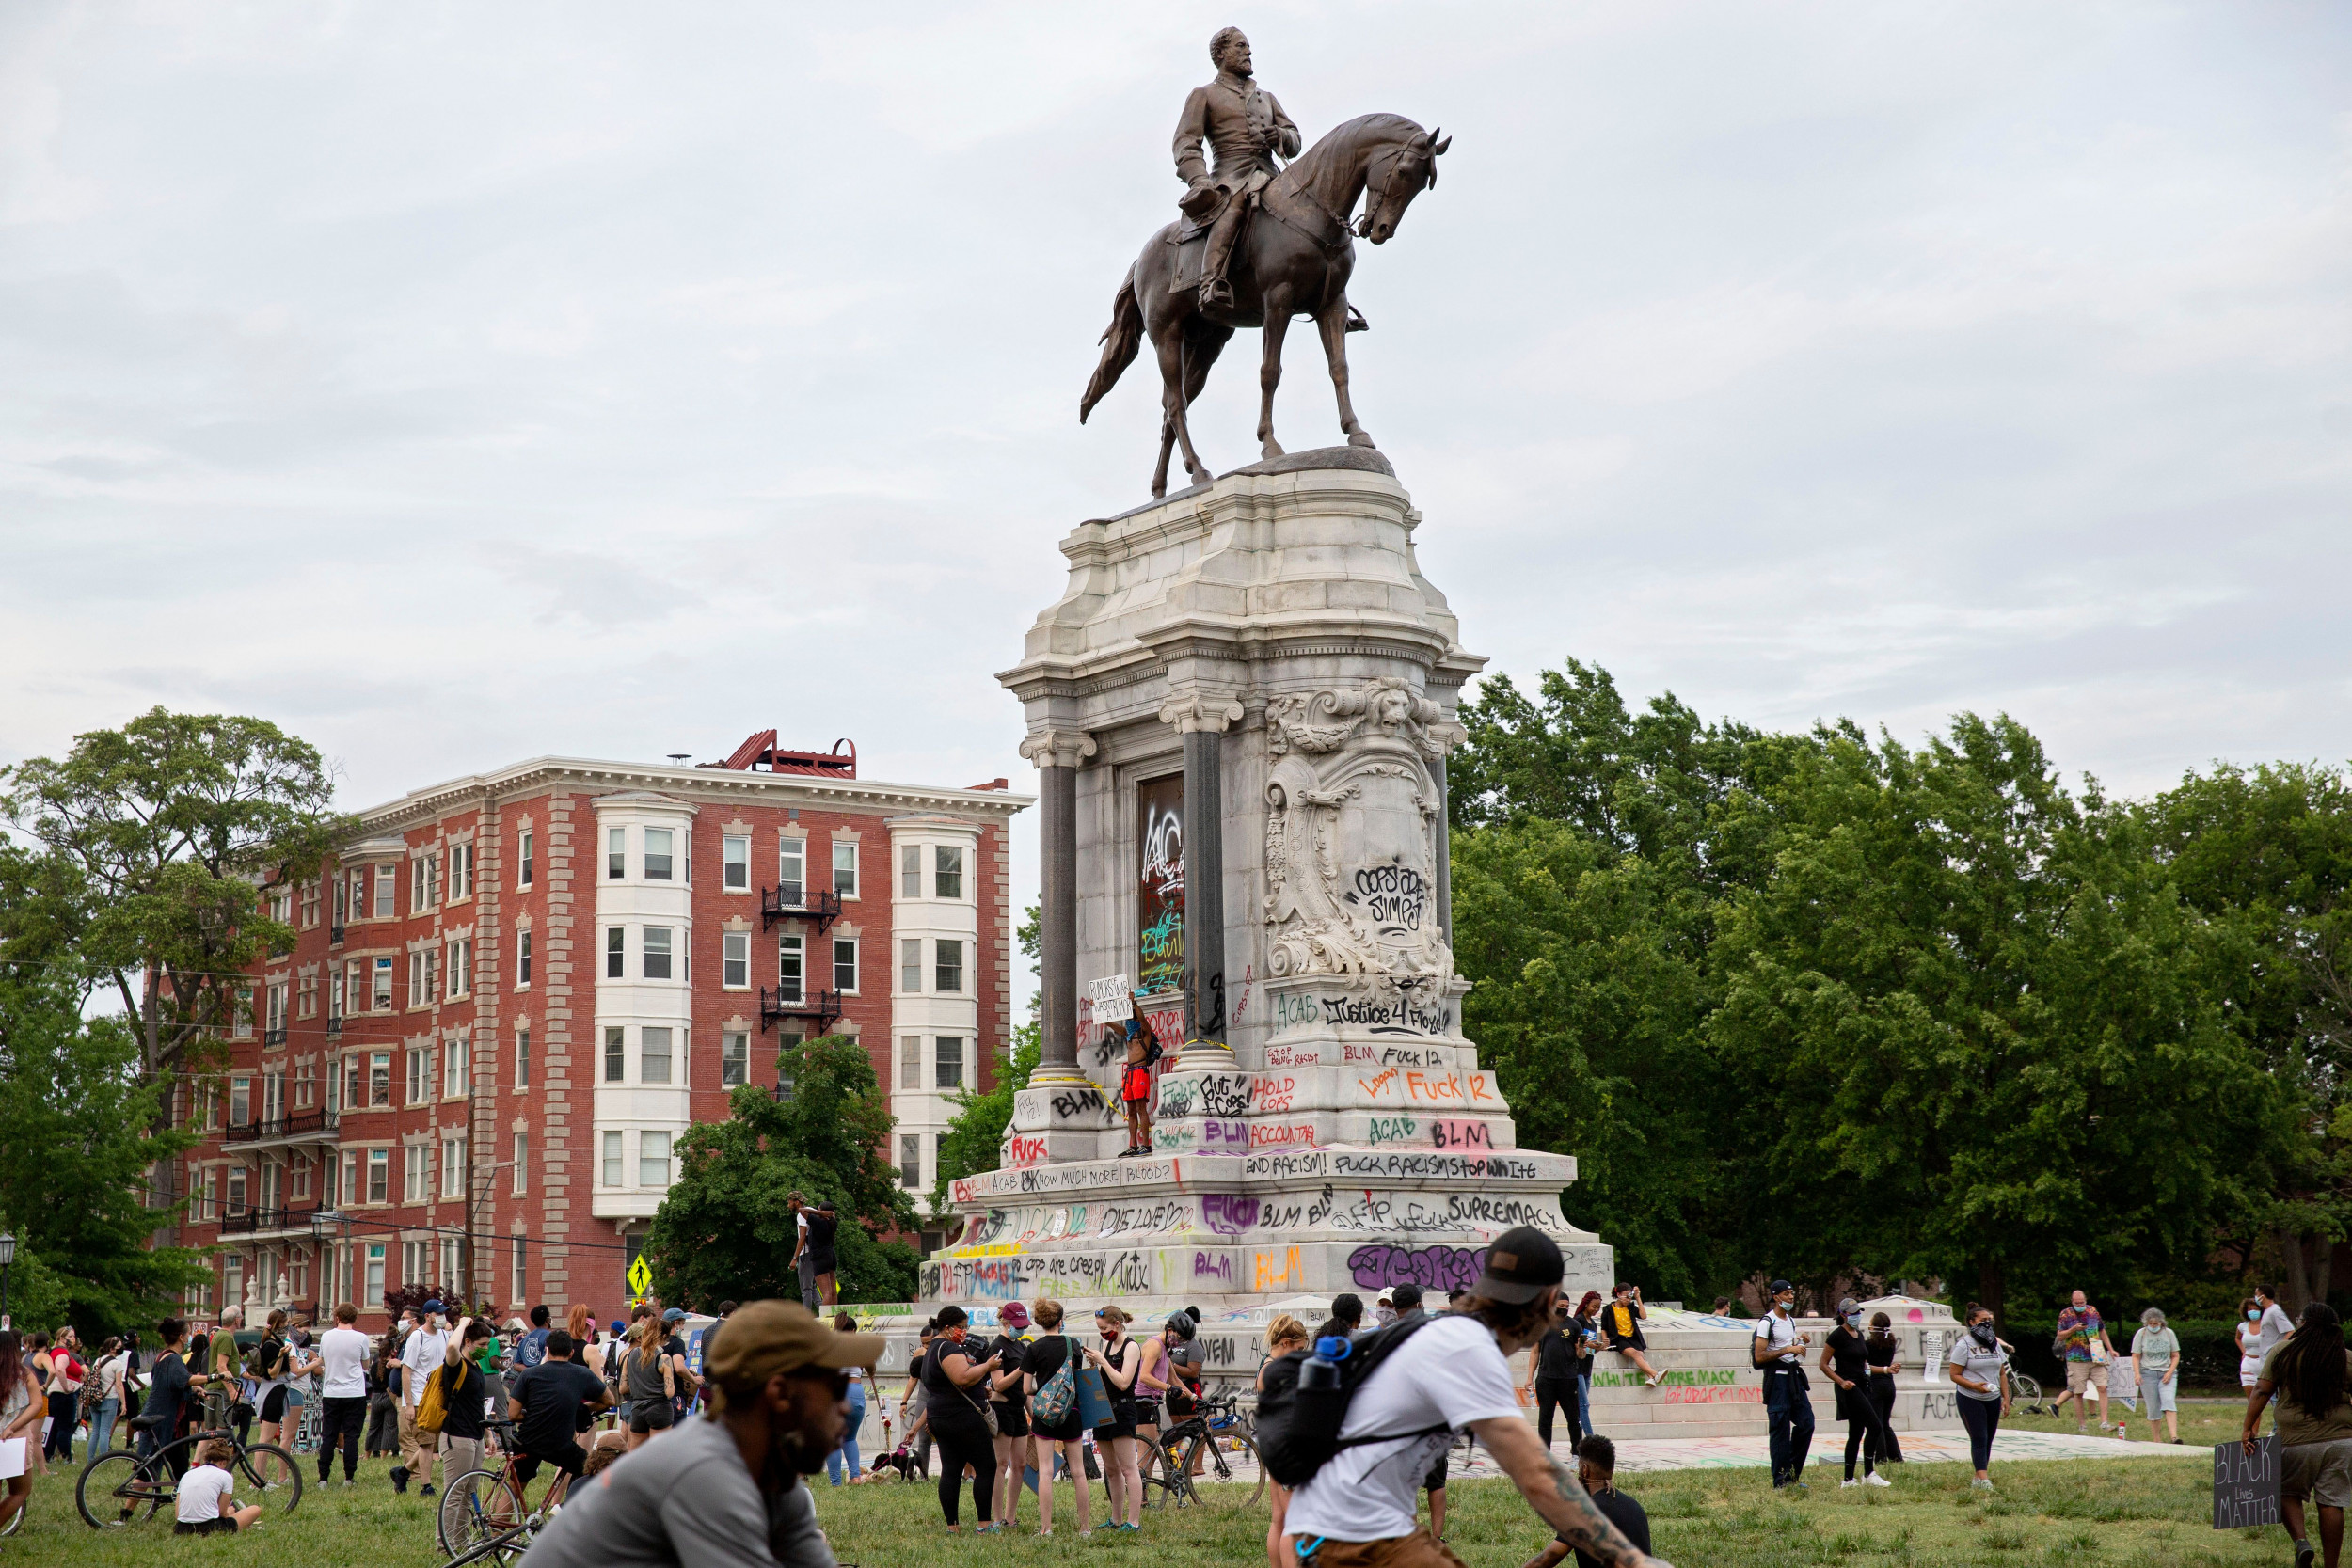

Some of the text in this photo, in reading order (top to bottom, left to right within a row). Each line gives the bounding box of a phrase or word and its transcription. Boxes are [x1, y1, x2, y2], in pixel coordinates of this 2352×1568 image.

[1090, 979, 1114, 1000] RUMORS
[1115, 981, 1128, 997] WAR
[1277, 992, 1318, 1031] ACAB
[1392, 999, 1407, 1025] 4
[1343, 1045, 1380, 1066] BLM
[1426, 1048, 1441, 1066] 12
[1252, 1077, 1295, 1101] HOLD
[1051, 1089, 1104, 1119] BLM
[1260, 1095, 1294, 1112] COPS
[1204, 1120, 1249, 1145] BLM
[1430, 1120, 1494, 1150] BLM
[1011, 1135, 1048, 1162] FUCK
[1040, 1172, 1057, 1188] HOW
[1061, 1169, 1088, 1186] MUCH
[1089, 1167, 1120, 1185] MORE
[1127, 1164, 1170, 1183] BLOOD?
[1247, 1153, 1327, 1179] END RACISM!
[993, 1173, 1018, 1194] ACAB
[1260, 1203, 1302, 1228] BLM
[1449, 1196, 1559, 1230] SUPREMACY
[1194, 1251, 1232, 1284] BLM
[1255, 1244, 1304, 1292] BLM
[1039, 1277, 1083, 1298] FREE
[1311, 1311, 1326, 1322] BLM
[1593, 1369, 1736, 1387] WHITE UPREMACY
[2216, 1437, 2273, 1485] BLACK
[2234, 1486, 2254, 1500] Lives
[2218, 1494, 2278, 1529] MATTER
